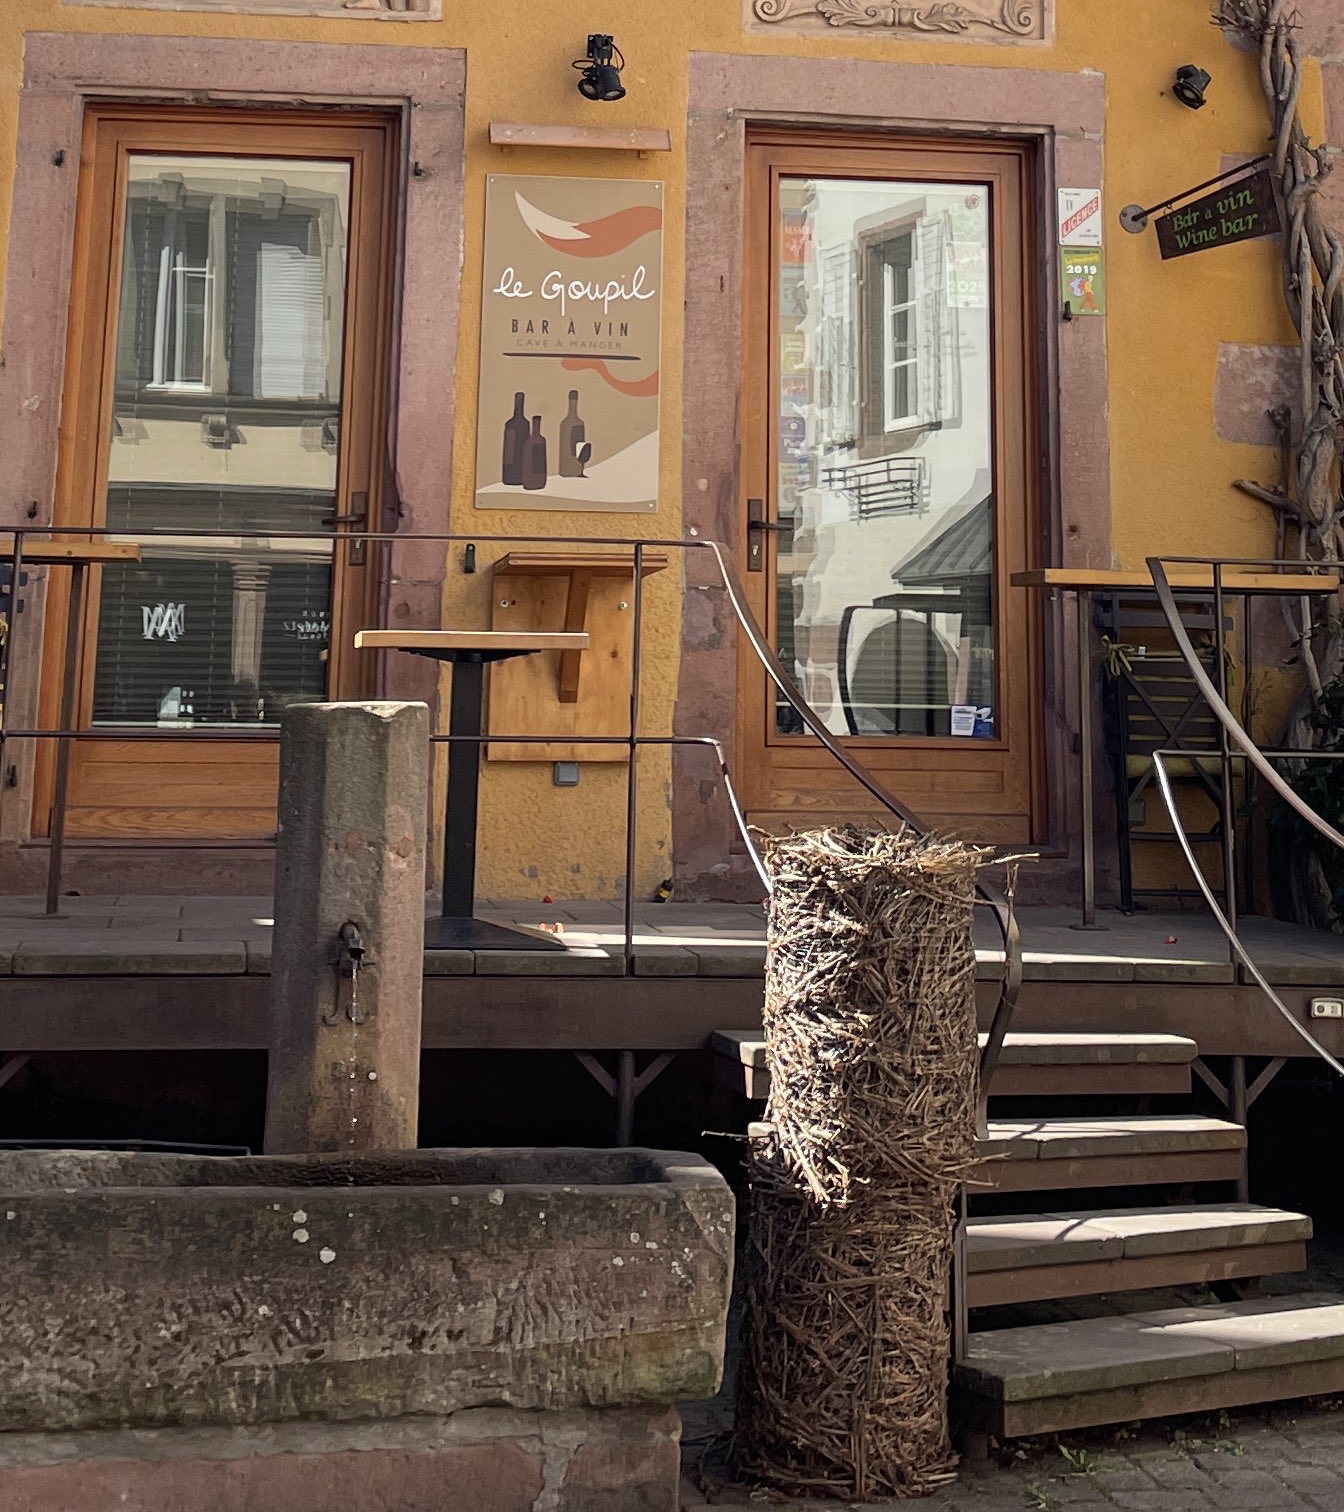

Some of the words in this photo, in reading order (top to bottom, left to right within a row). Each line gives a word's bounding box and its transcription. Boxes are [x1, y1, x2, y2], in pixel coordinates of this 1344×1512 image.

[1216, 189, 1255, 215] vin
[1062, 198, 1098, 236] LICENCE
[1219, 213, 1259, 237] bar
[540, 265, 656, 317] Goupil
[511, 318, 549, 334] BAR
[567, 317, 576, 335] À
[593, 321, 629, 337] VIN
[516, 338, 549, 348] CAVE
[569, 340, 623, 350] MANGER
